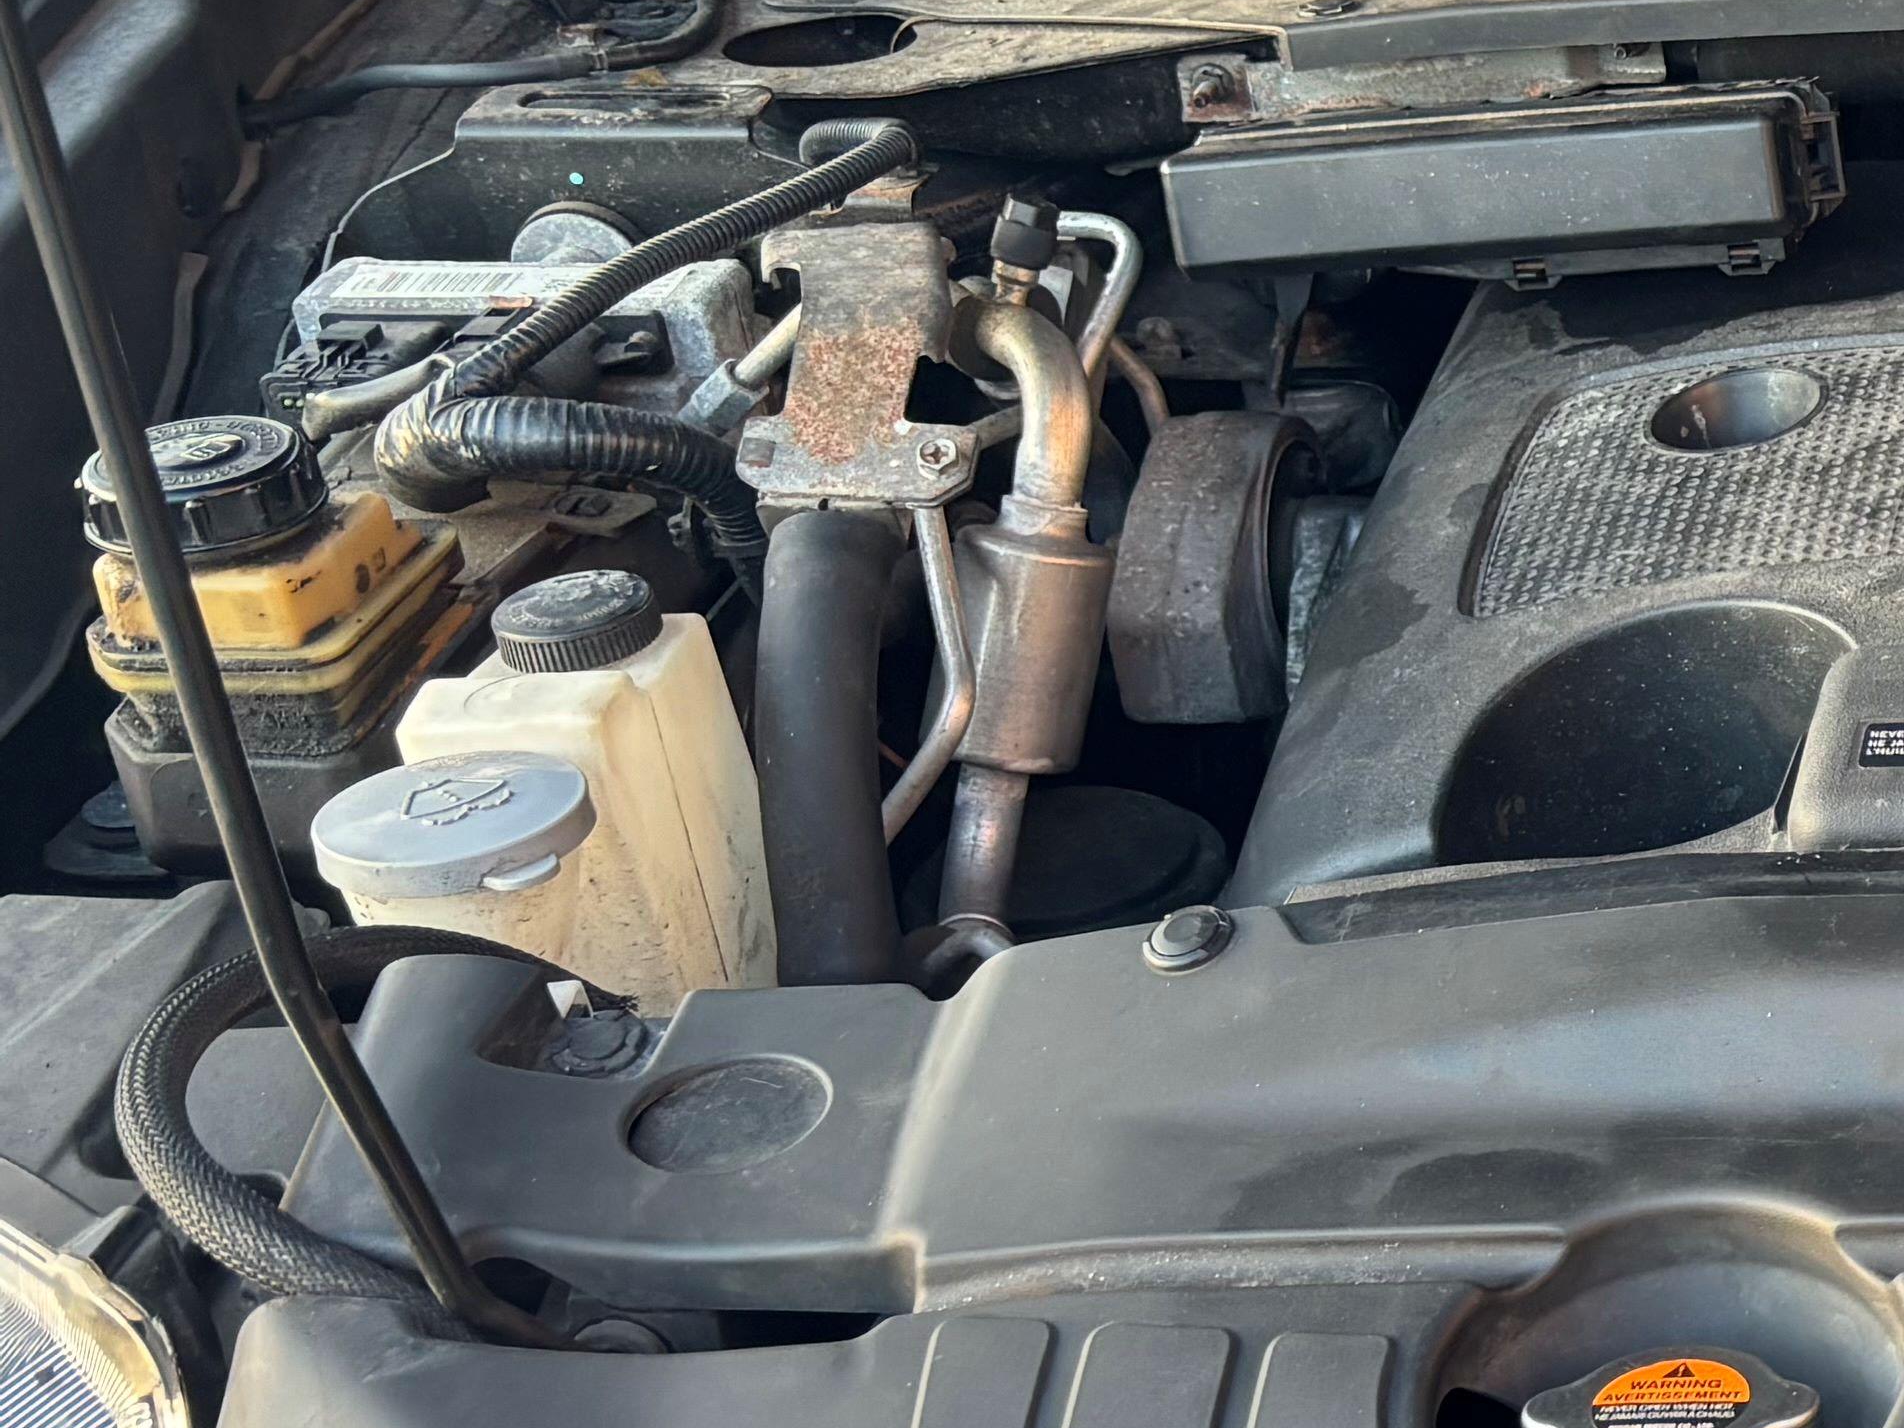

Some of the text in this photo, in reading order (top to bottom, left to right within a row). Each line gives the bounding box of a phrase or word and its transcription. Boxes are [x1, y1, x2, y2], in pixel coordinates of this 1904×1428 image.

[1868, 739, 1888, 747] NE
[1630, 1379, 1722, 1390] WARNING
[1604, 1390, 1742, 1402] AVERTISSEMENT
[1600, 1404, 1637, 1413] NEVER
[1639, 1404, 1671, 1412] OPEN
[1673, 1403, 1707, 1411] WHEN
